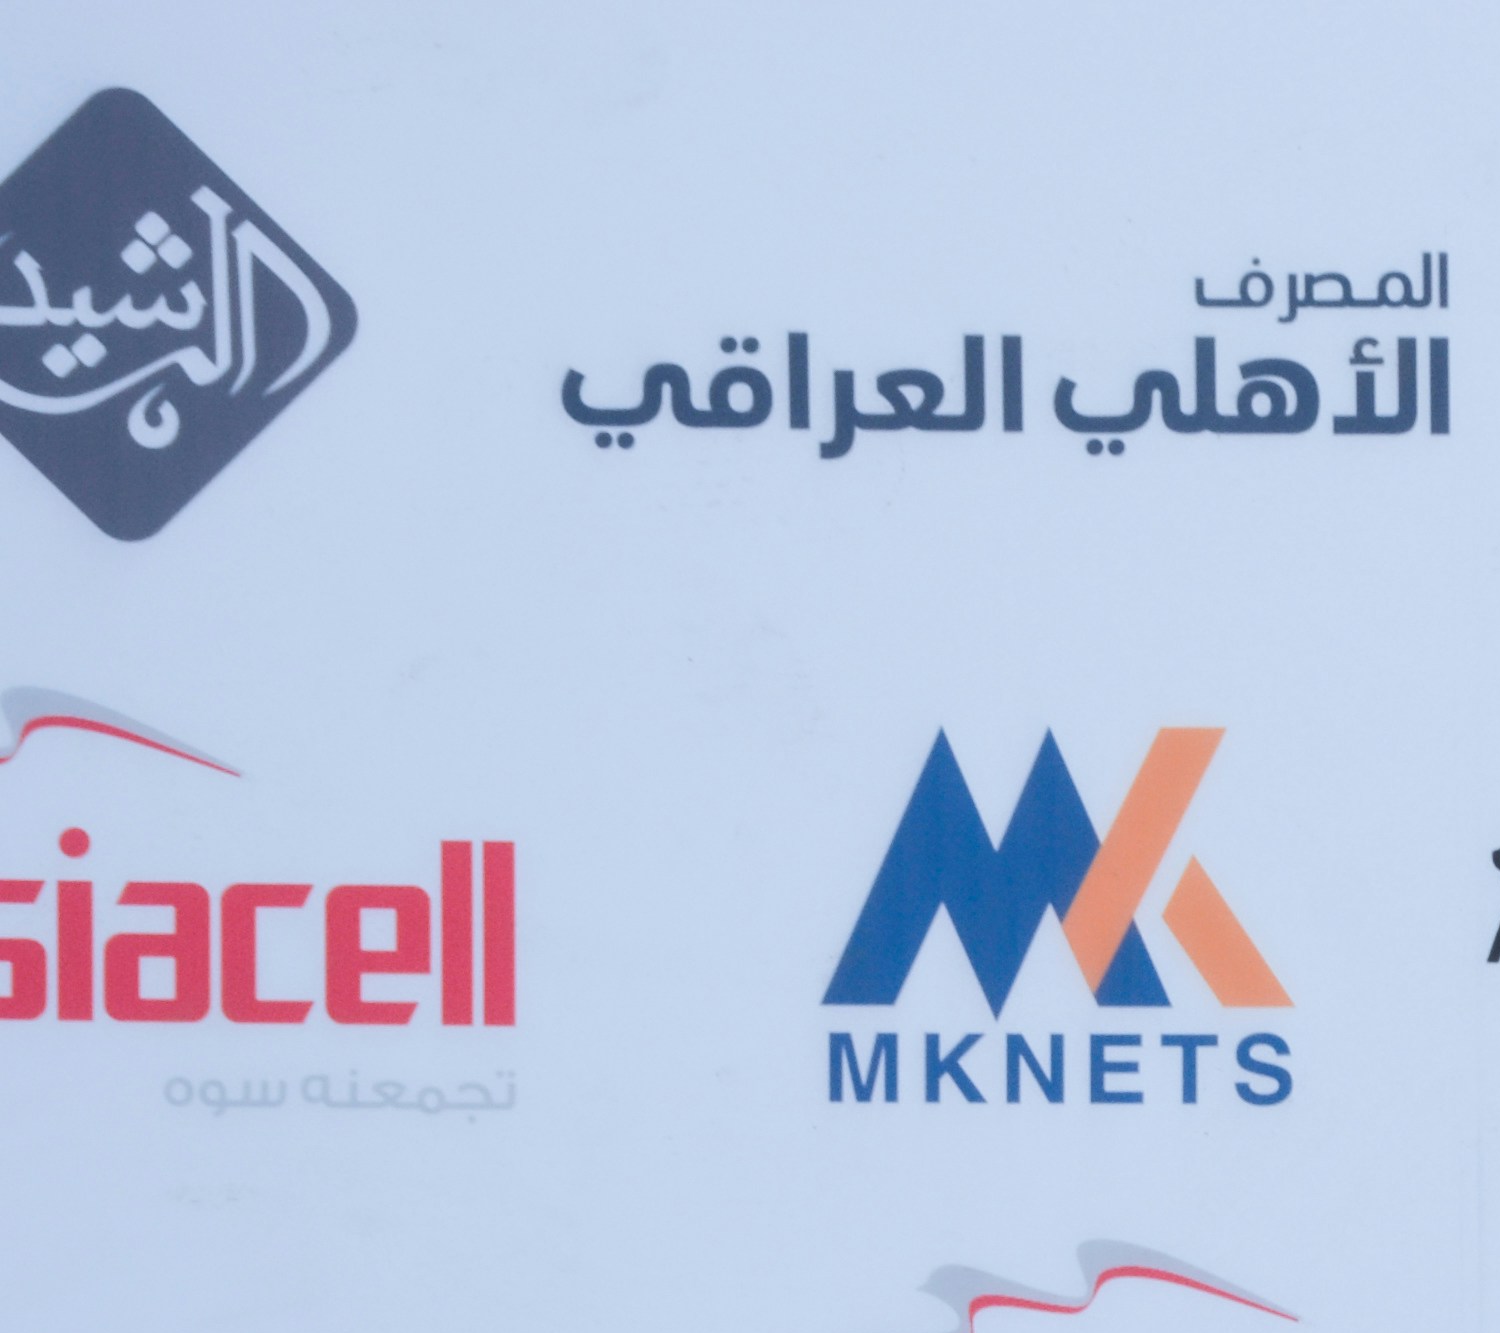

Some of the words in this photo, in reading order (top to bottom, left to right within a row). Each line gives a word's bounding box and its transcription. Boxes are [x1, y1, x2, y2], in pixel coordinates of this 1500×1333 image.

[1194, 252, 1449, 324] المصرف
[560, 331, 1024, 460] العراقي
[1053, 336, 1450, 456] الأهلي
[165, 1078, 286, 1115] سوه
[828, 1032, 1293, 1107] MKNETS
